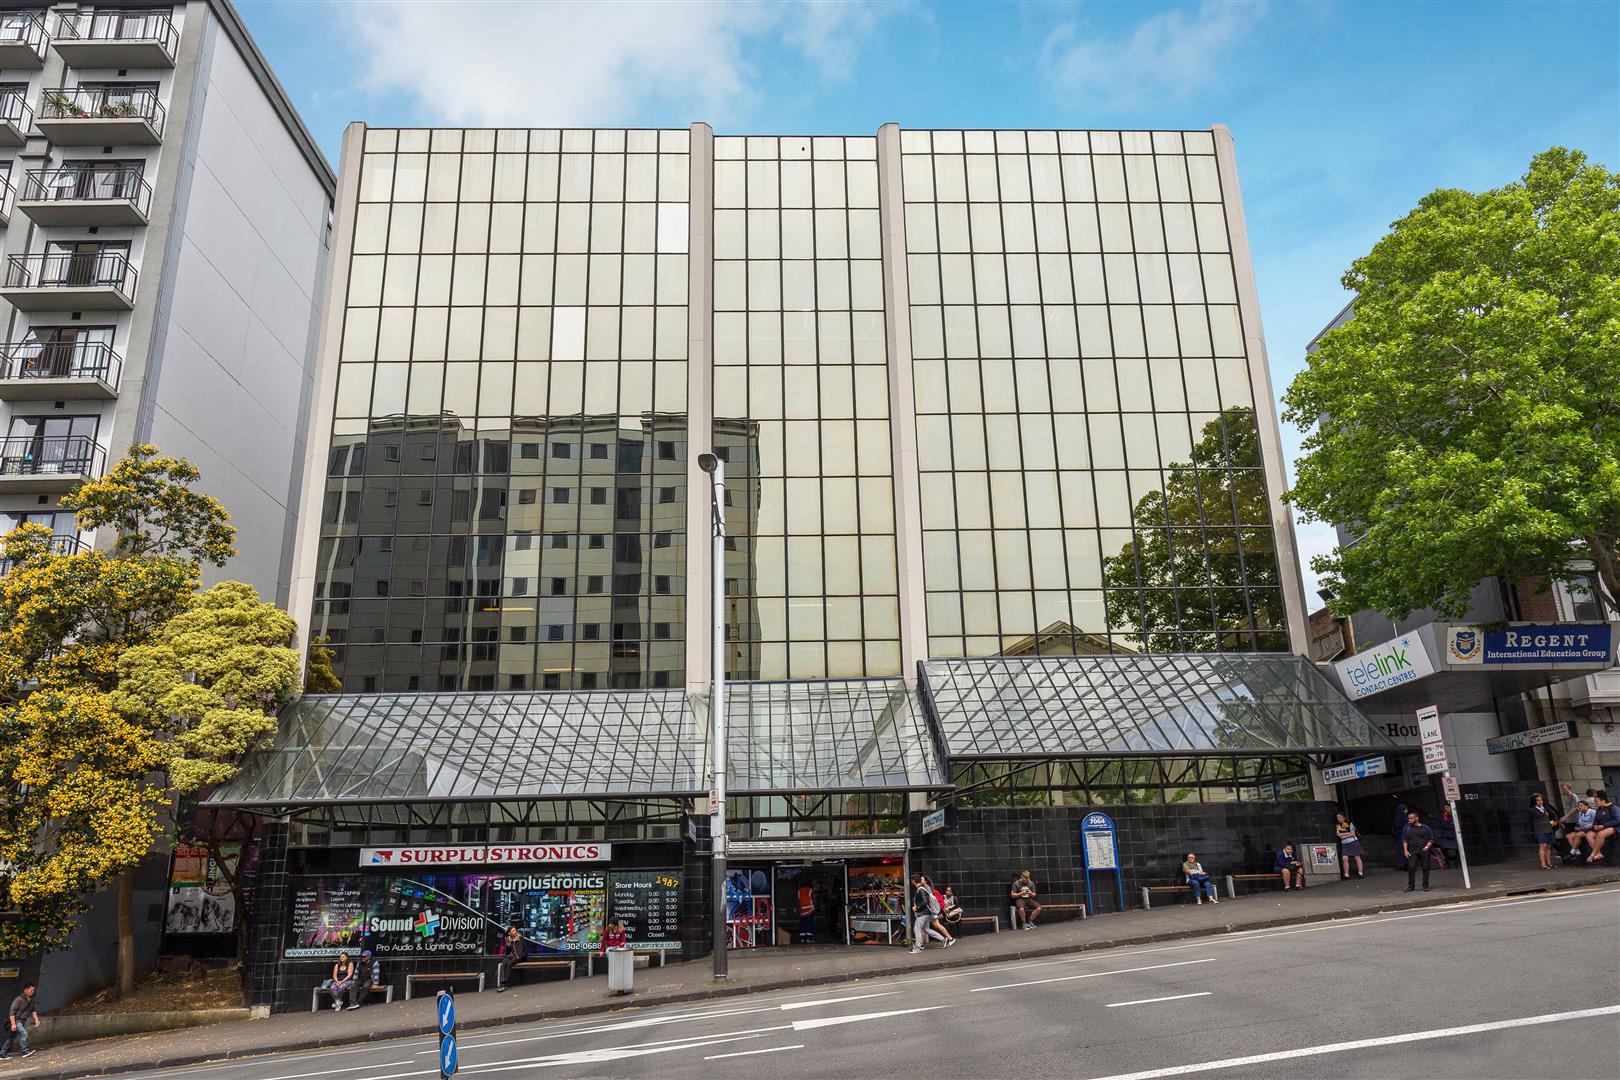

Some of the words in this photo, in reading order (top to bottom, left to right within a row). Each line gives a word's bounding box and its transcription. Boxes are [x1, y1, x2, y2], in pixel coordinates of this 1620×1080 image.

[1505, 631, 1589, 648] REGENT
[1487, 650, 1538, 659] International
[1582, 650, 1606, 659] Group
[1346, 646, 1412, 687] telelink
[1356, 680, 1387, 697] CONTACT
[1387, 670, 1417, 687] CENTRES
[1386, 723, 1418, 737] HOU
[1423, 730, 1438, 739] LANE
[400, 845, 599, 863] SURPLUSTRONICS
[493, 875, 604, 893] surplustronics
[371, 917, 414, 932] Sound
[440, 916, 484, 930] Division
[425, 942, 454, 951] Lighting
[455, 941, 476, 950] Store
